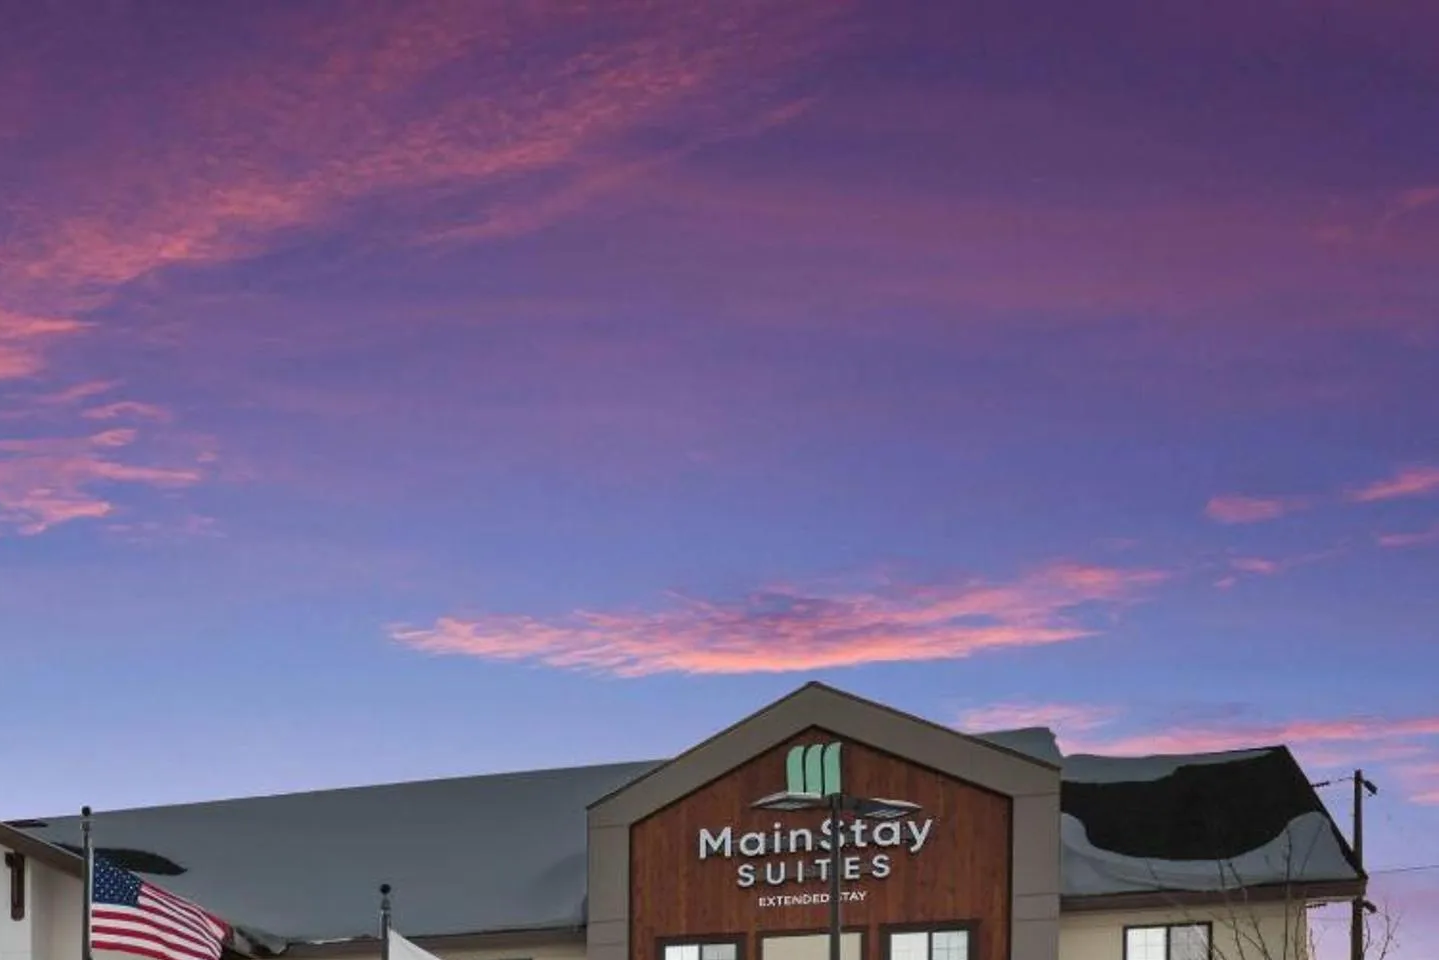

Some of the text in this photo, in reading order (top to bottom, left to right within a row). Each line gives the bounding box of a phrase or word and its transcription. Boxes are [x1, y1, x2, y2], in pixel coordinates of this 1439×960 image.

[698, 817, 933, 859] MainStay
[737, 853, 892, 887] SUITES
[758, 893, 830, 907] EXTENDED
